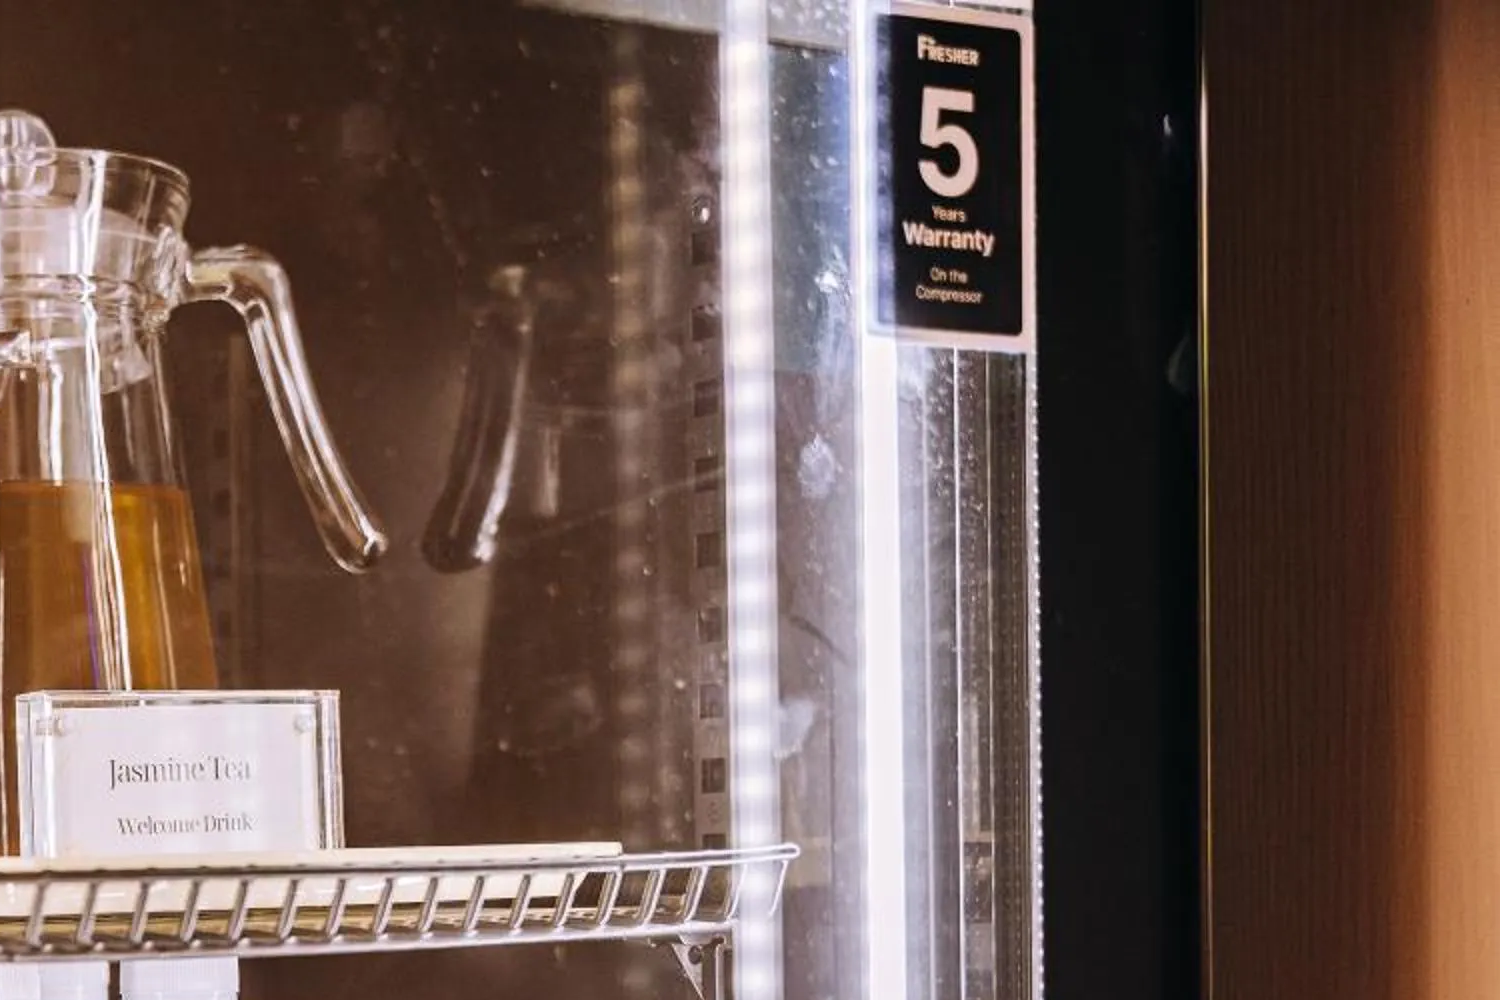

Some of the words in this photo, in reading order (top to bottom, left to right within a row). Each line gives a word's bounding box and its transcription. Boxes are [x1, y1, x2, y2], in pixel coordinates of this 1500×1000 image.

[918, 85, 980, 197] 5
[931, 204, 966, 223] Years
[902, 219, 995, 257] Warranty
[930, 265, 947, 282] On
[949, 269, 968, 284] the
[915, 284, 983, 304] Compressor
[109, 756, 204, 789] Jasmine
[206, 756, 251, 782] Tea
[116, 815, 201, 836] Welcome
[203, 813, 253, 833] Drink
